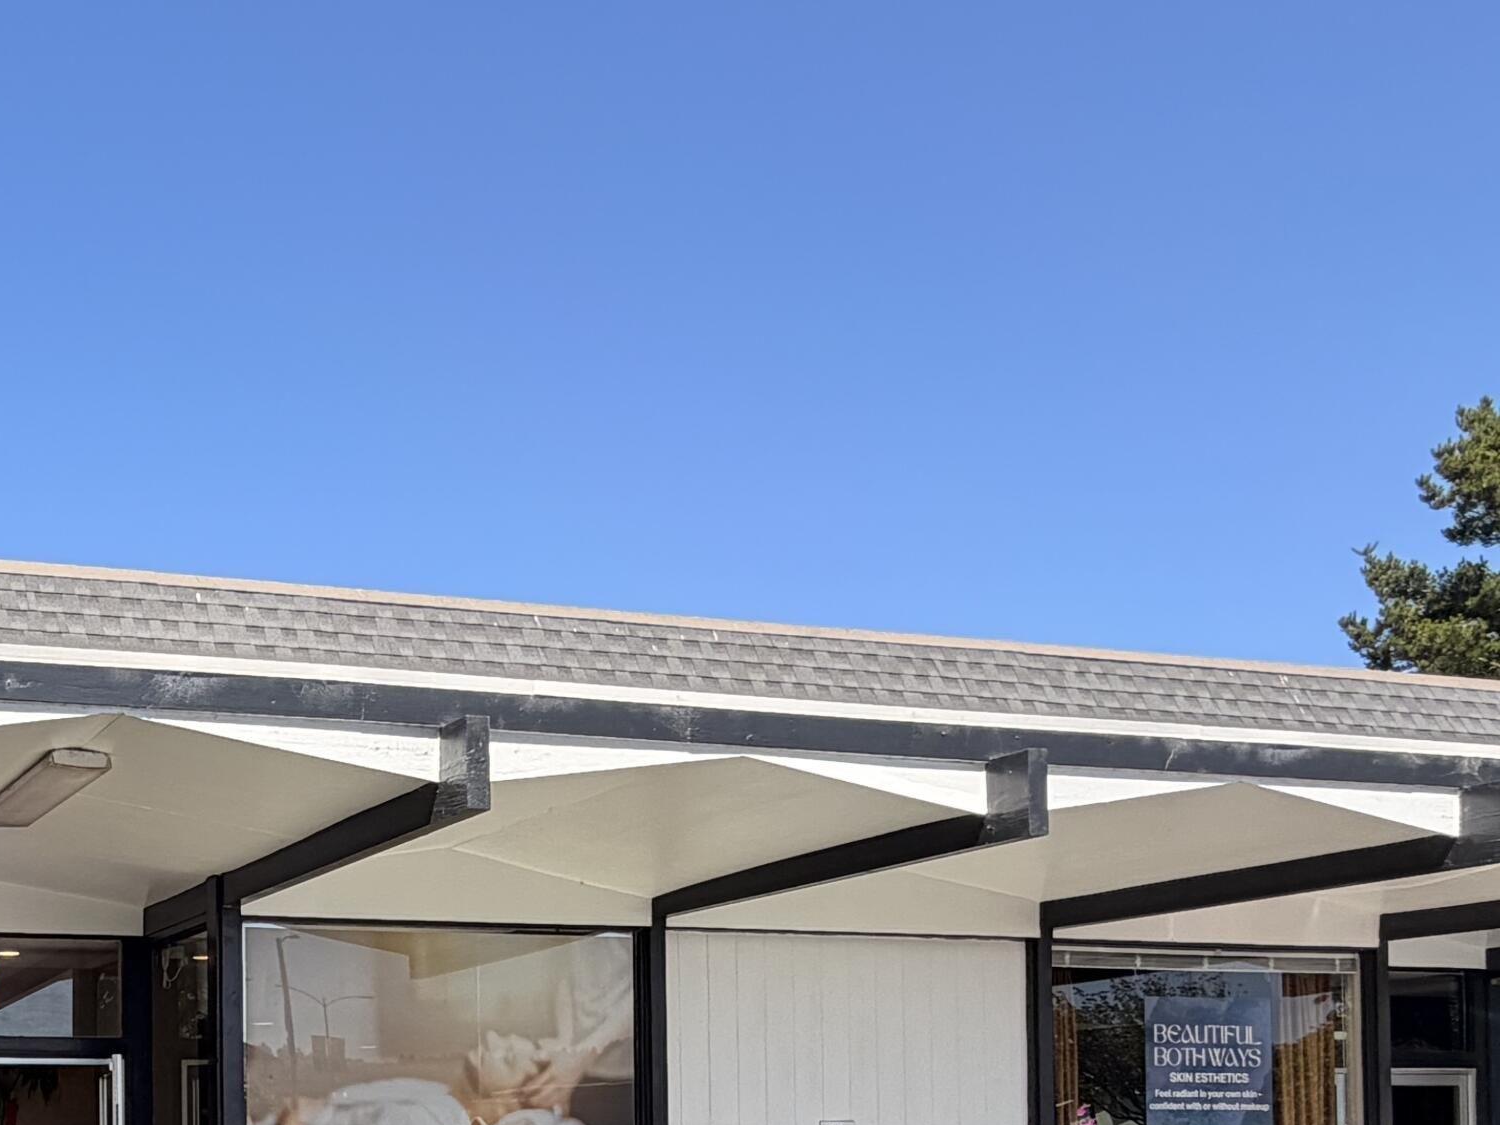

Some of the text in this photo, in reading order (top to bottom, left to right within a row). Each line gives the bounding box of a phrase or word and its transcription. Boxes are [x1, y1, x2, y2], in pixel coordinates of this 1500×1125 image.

[1153, 1023, 1262, 1045] BEAUTIFUL
[1153, 1046, 1261, 1068] BOTH WAYS
[1169, 1072, 1250, 1084] SKIN ESTHETICS
[1155, 1089, 1171, 1098] Feel
[1172, 1089, 1199, 1098] radiant
[1207, 1091, 1224, 1100] your
[1242, 1090, 1257, 1098] skin
[1149, 1102, 1185, 1111] confident
[1186, 1102, 1202, 1111] with
[1212, 1103, 1239, 1111] without
[1240, 1103, 1270, 1112] makeup
